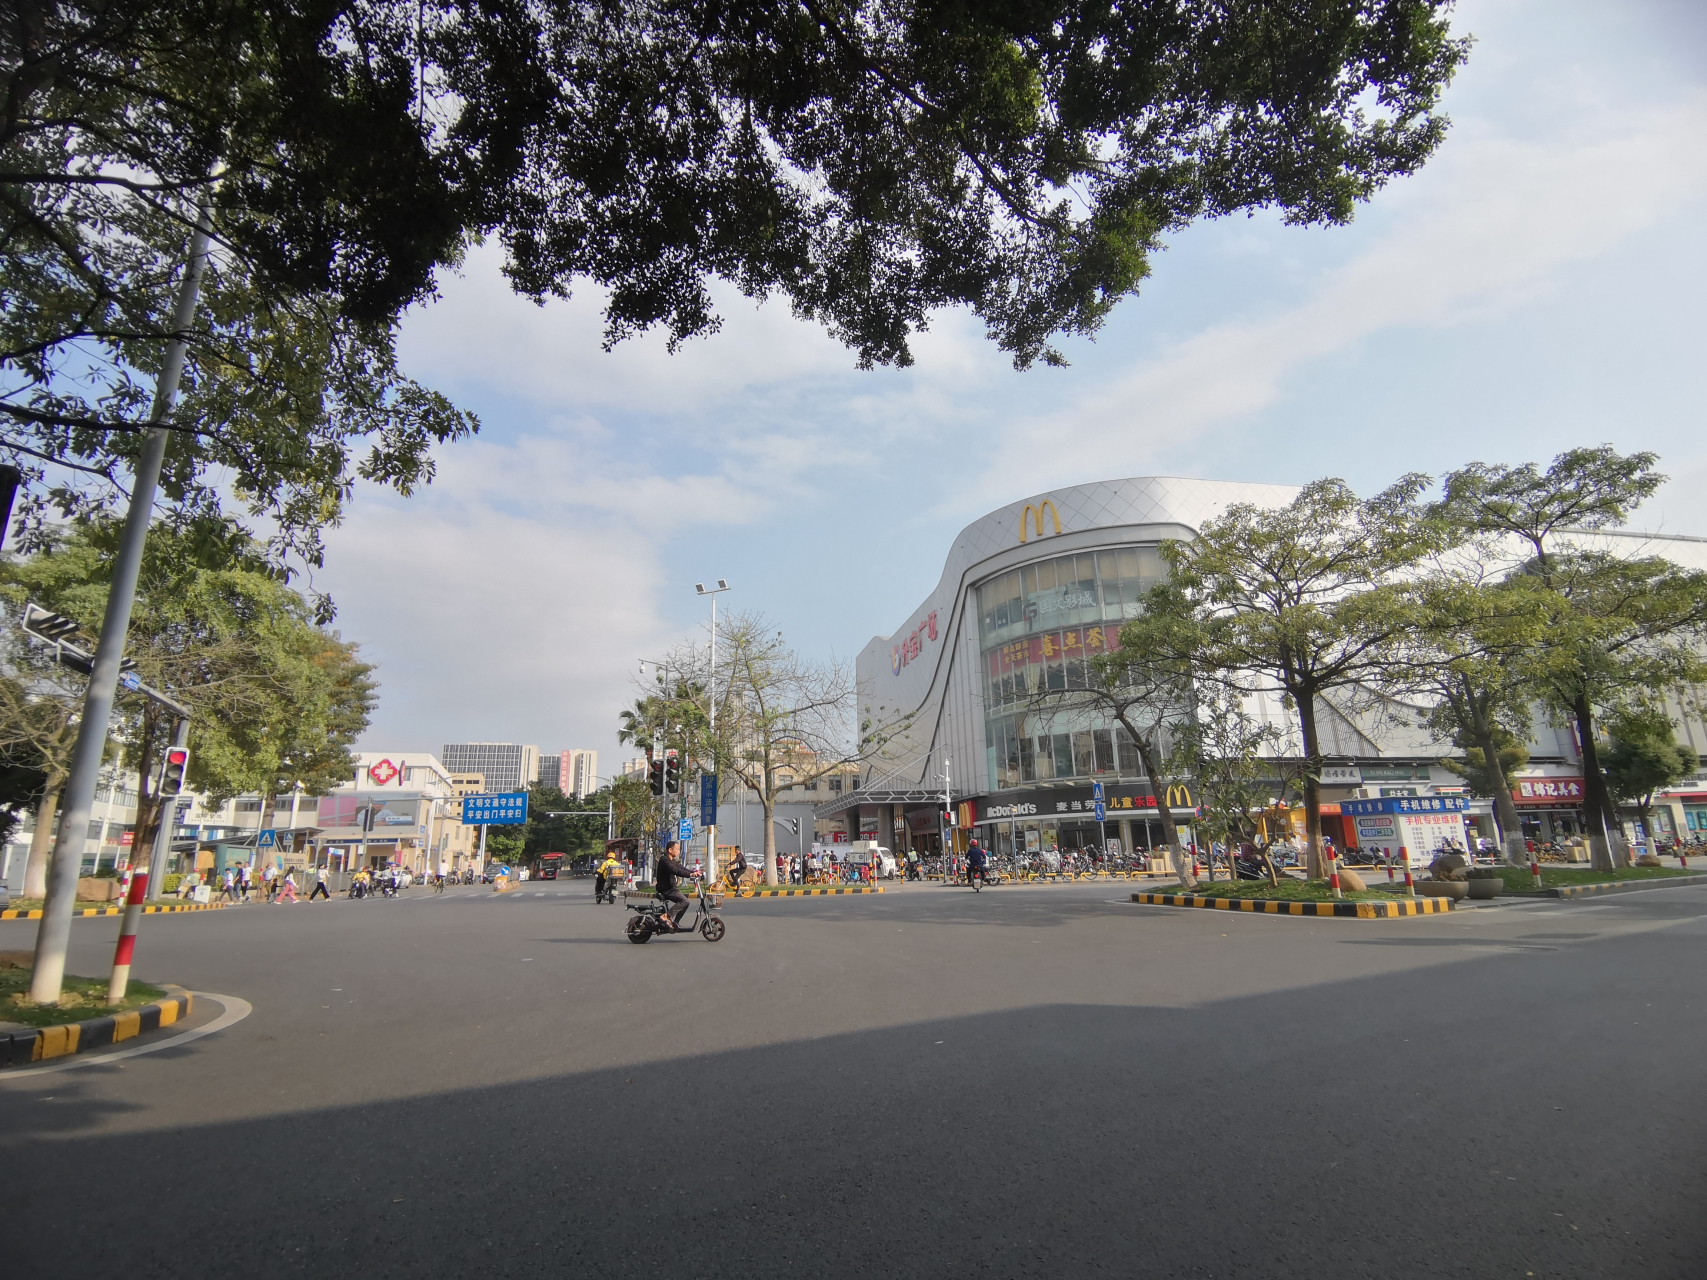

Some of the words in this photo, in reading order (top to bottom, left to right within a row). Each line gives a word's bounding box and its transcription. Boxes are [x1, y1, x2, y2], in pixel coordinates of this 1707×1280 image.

[468, 798, 523, 808] 文明交通守法规
[1056, 799, 1096, 812] 麦当劳
[1110, 795, 1157, 809] 儿童乐园
[1400, 799, 1441, 811] 手机维修
[1444, 797, 1465, 809] 配件
[467, 809, 522, 819] 平安出门平安归
[1405, 815, 1459, 825] 手机专业维修
